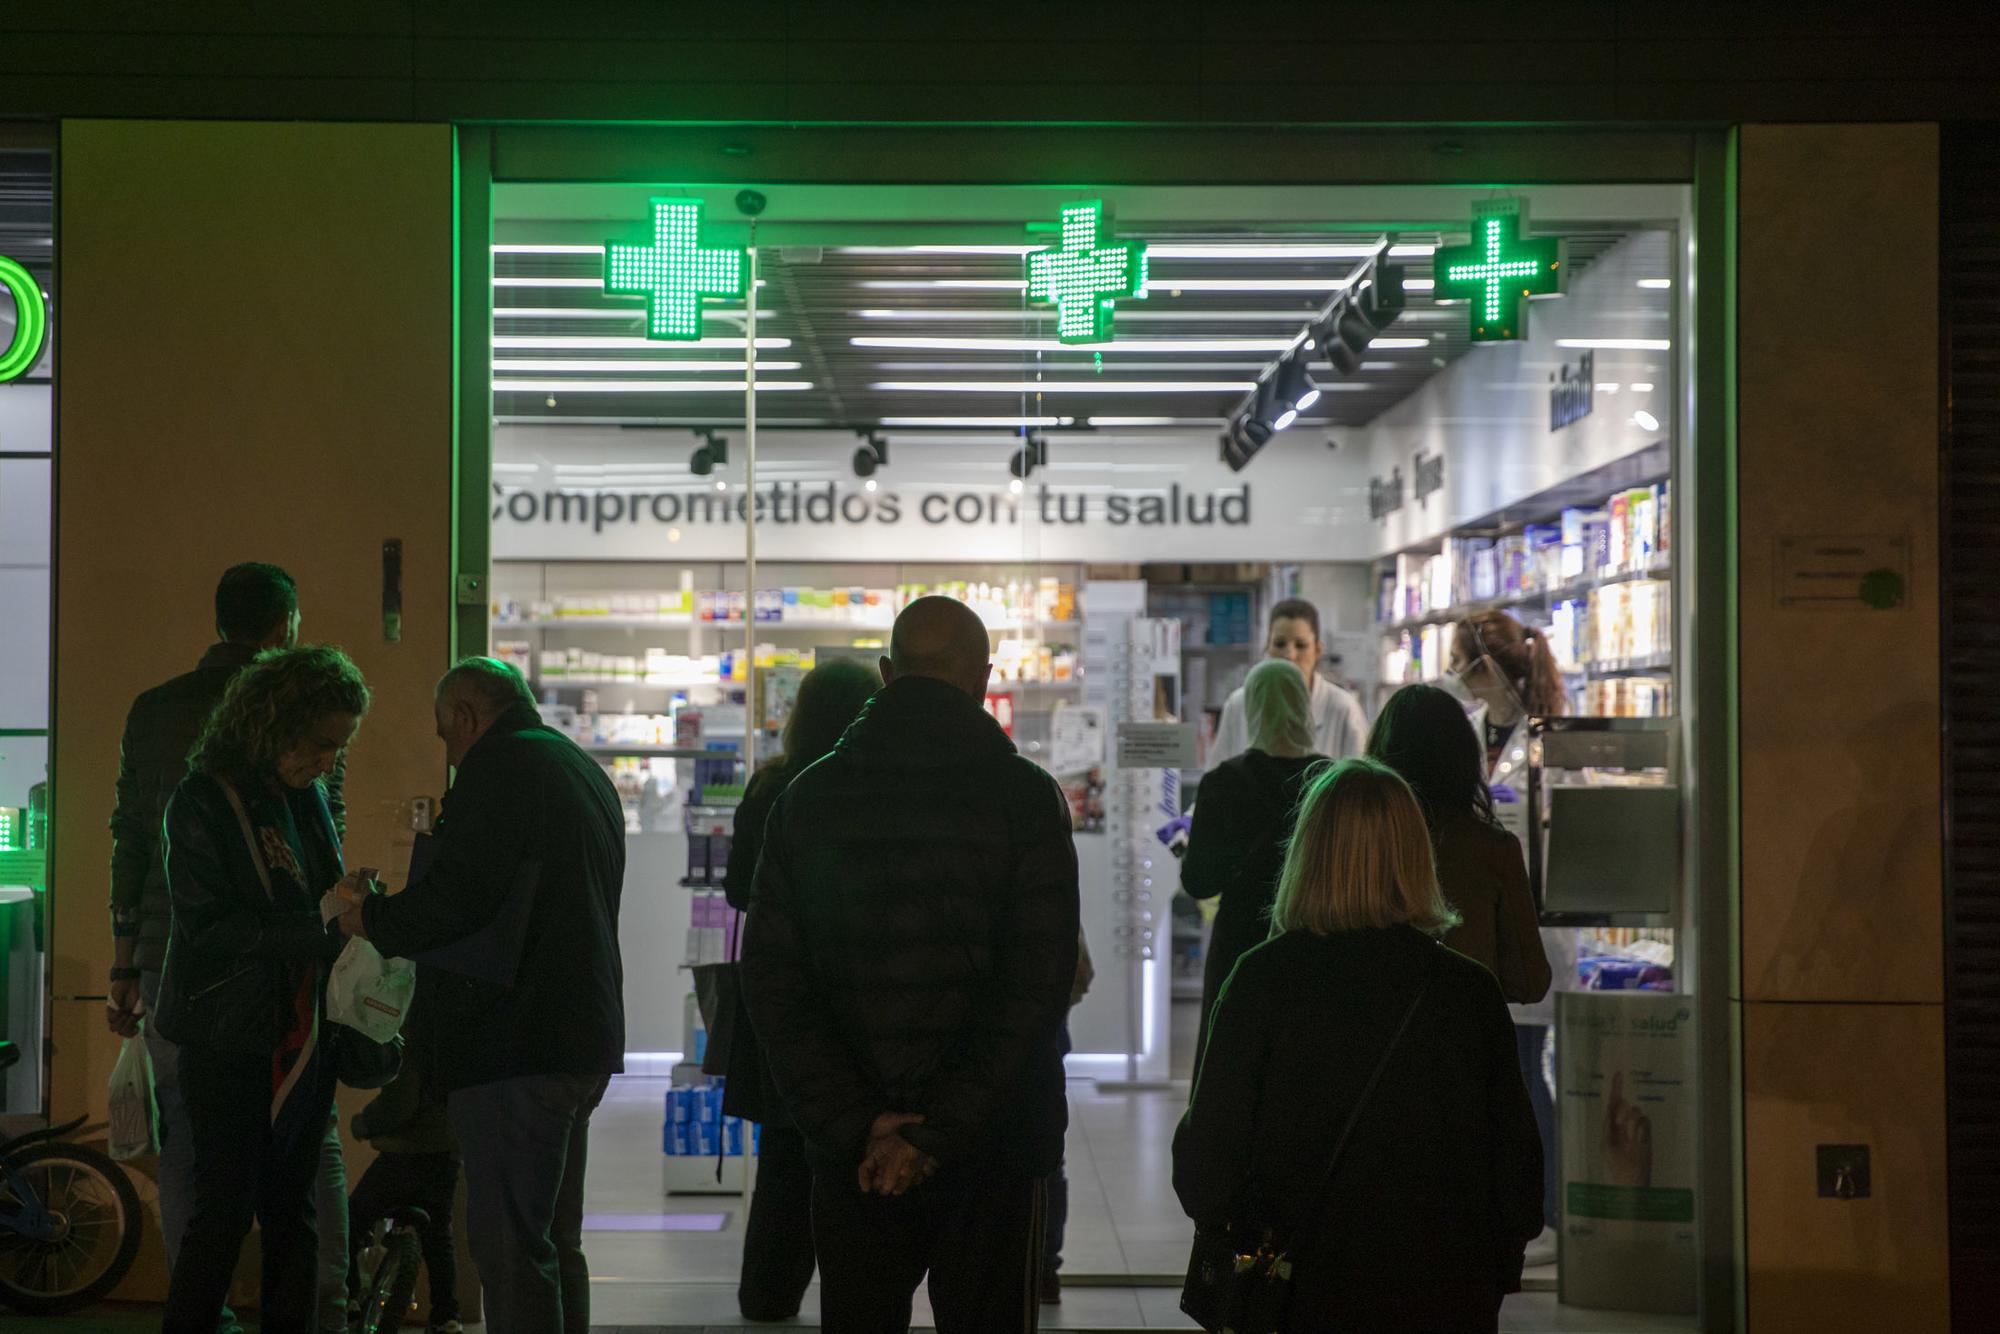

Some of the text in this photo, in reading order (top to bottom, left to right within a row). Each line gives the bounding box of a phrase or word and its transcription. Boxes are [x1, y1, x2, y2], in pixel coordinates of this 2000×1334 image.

[921, 492, 1017, 525] con
[1039, 483, 1086, 524] tu
[1106, 482, 1251, 525] salud
